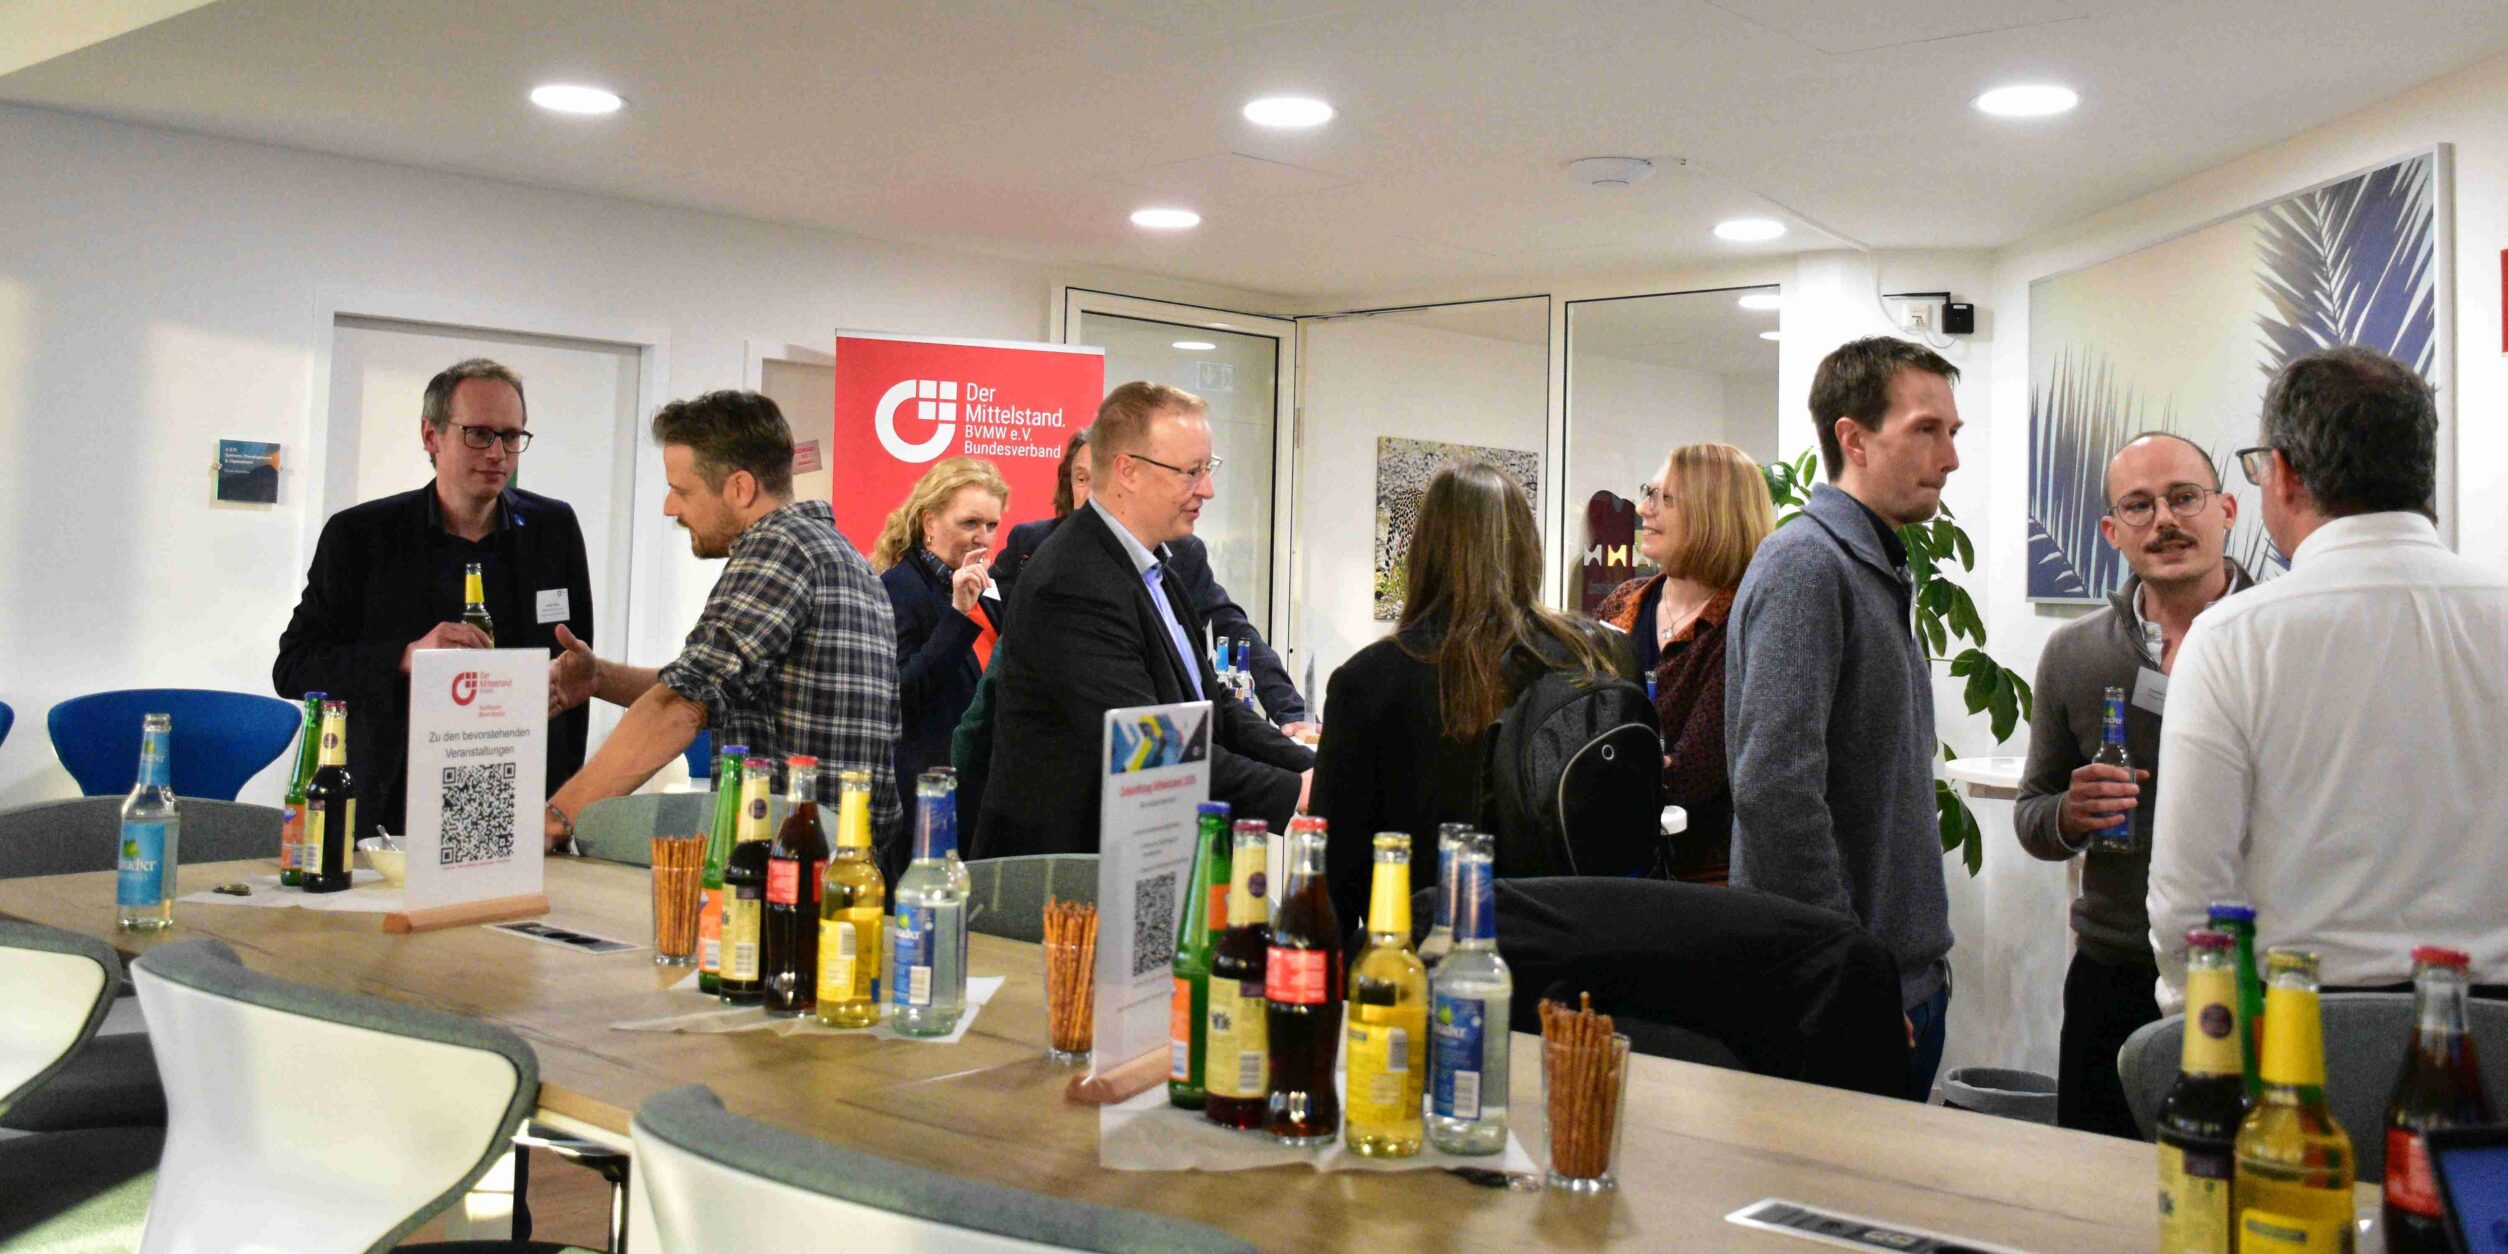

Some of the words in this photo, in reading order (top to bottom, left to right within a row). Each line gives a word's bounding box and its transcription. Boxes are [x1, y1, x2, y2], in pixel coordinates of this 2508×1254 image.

[966, 382, 996, 402] Der
[965, 403, 1066, 428] Mittelstand.
[965, 424, 1007, 440] BVMW
[1010, 427, 1032, 441] e.V.
[964, 440, 1061, 459] Bundesverband
[429, 731, 441, 743] Zu
[443, 730, 460, 742] den
[462, 728, 531, 741] bevorstehenden
[445, 745, 515, 758] Veranstaltungen
